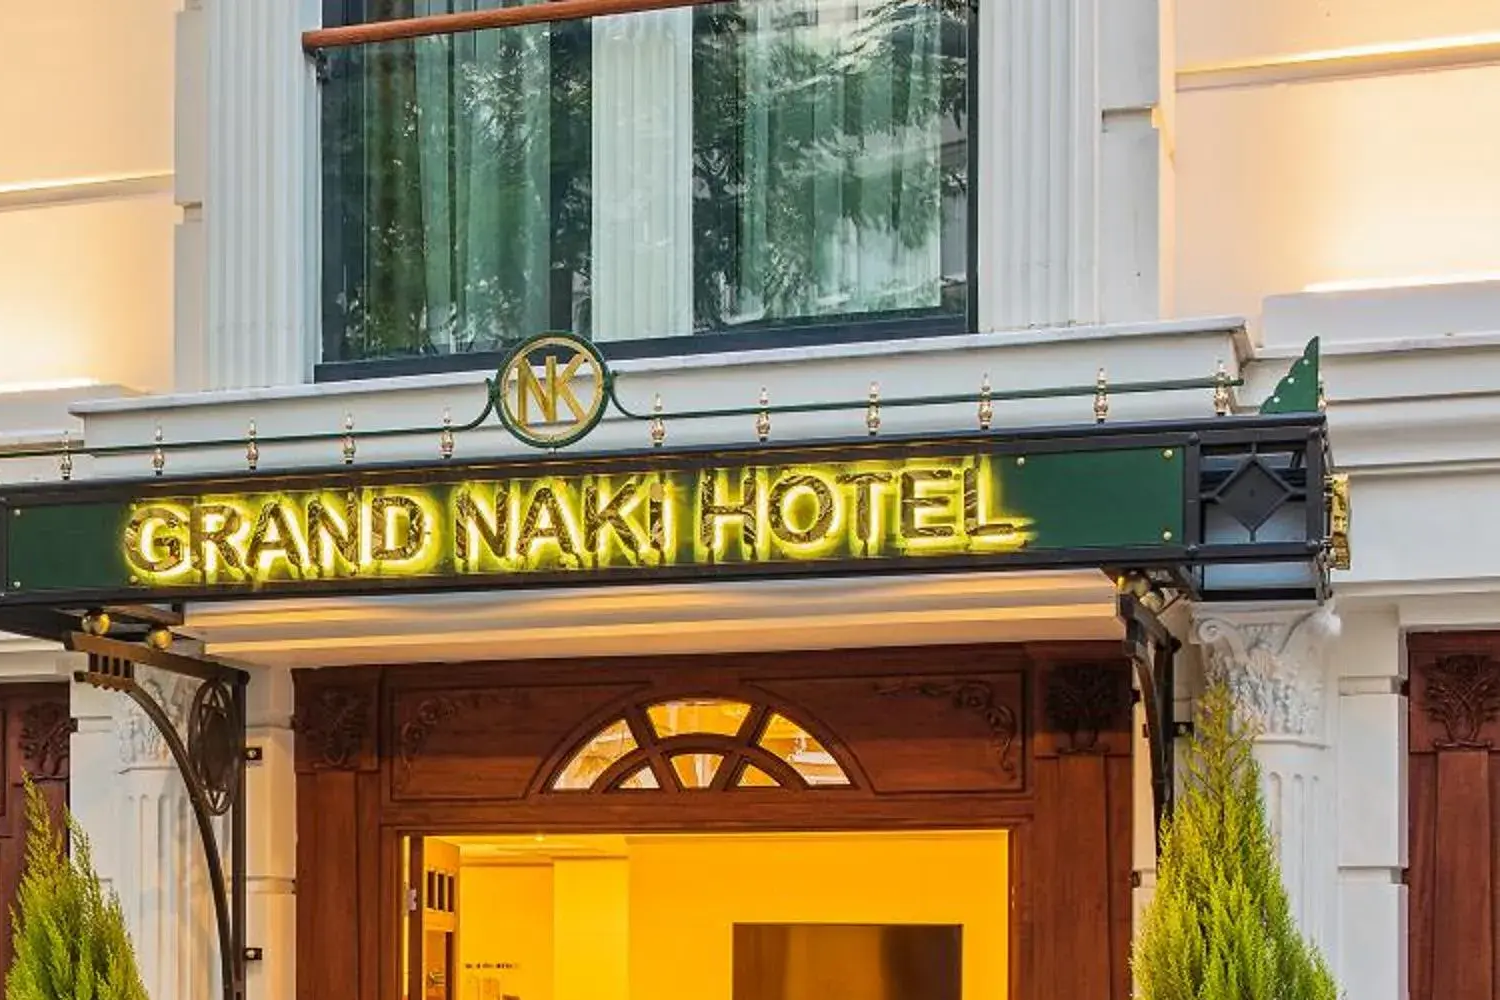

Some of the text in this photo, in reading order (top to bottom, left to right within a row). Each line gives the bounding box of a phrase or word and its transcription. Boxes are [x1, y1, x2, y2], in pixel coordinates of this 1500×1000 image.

[517, 352, 587, 426] NK
[123, 460, 1028, 581] GRAND NAKI HOTEL
